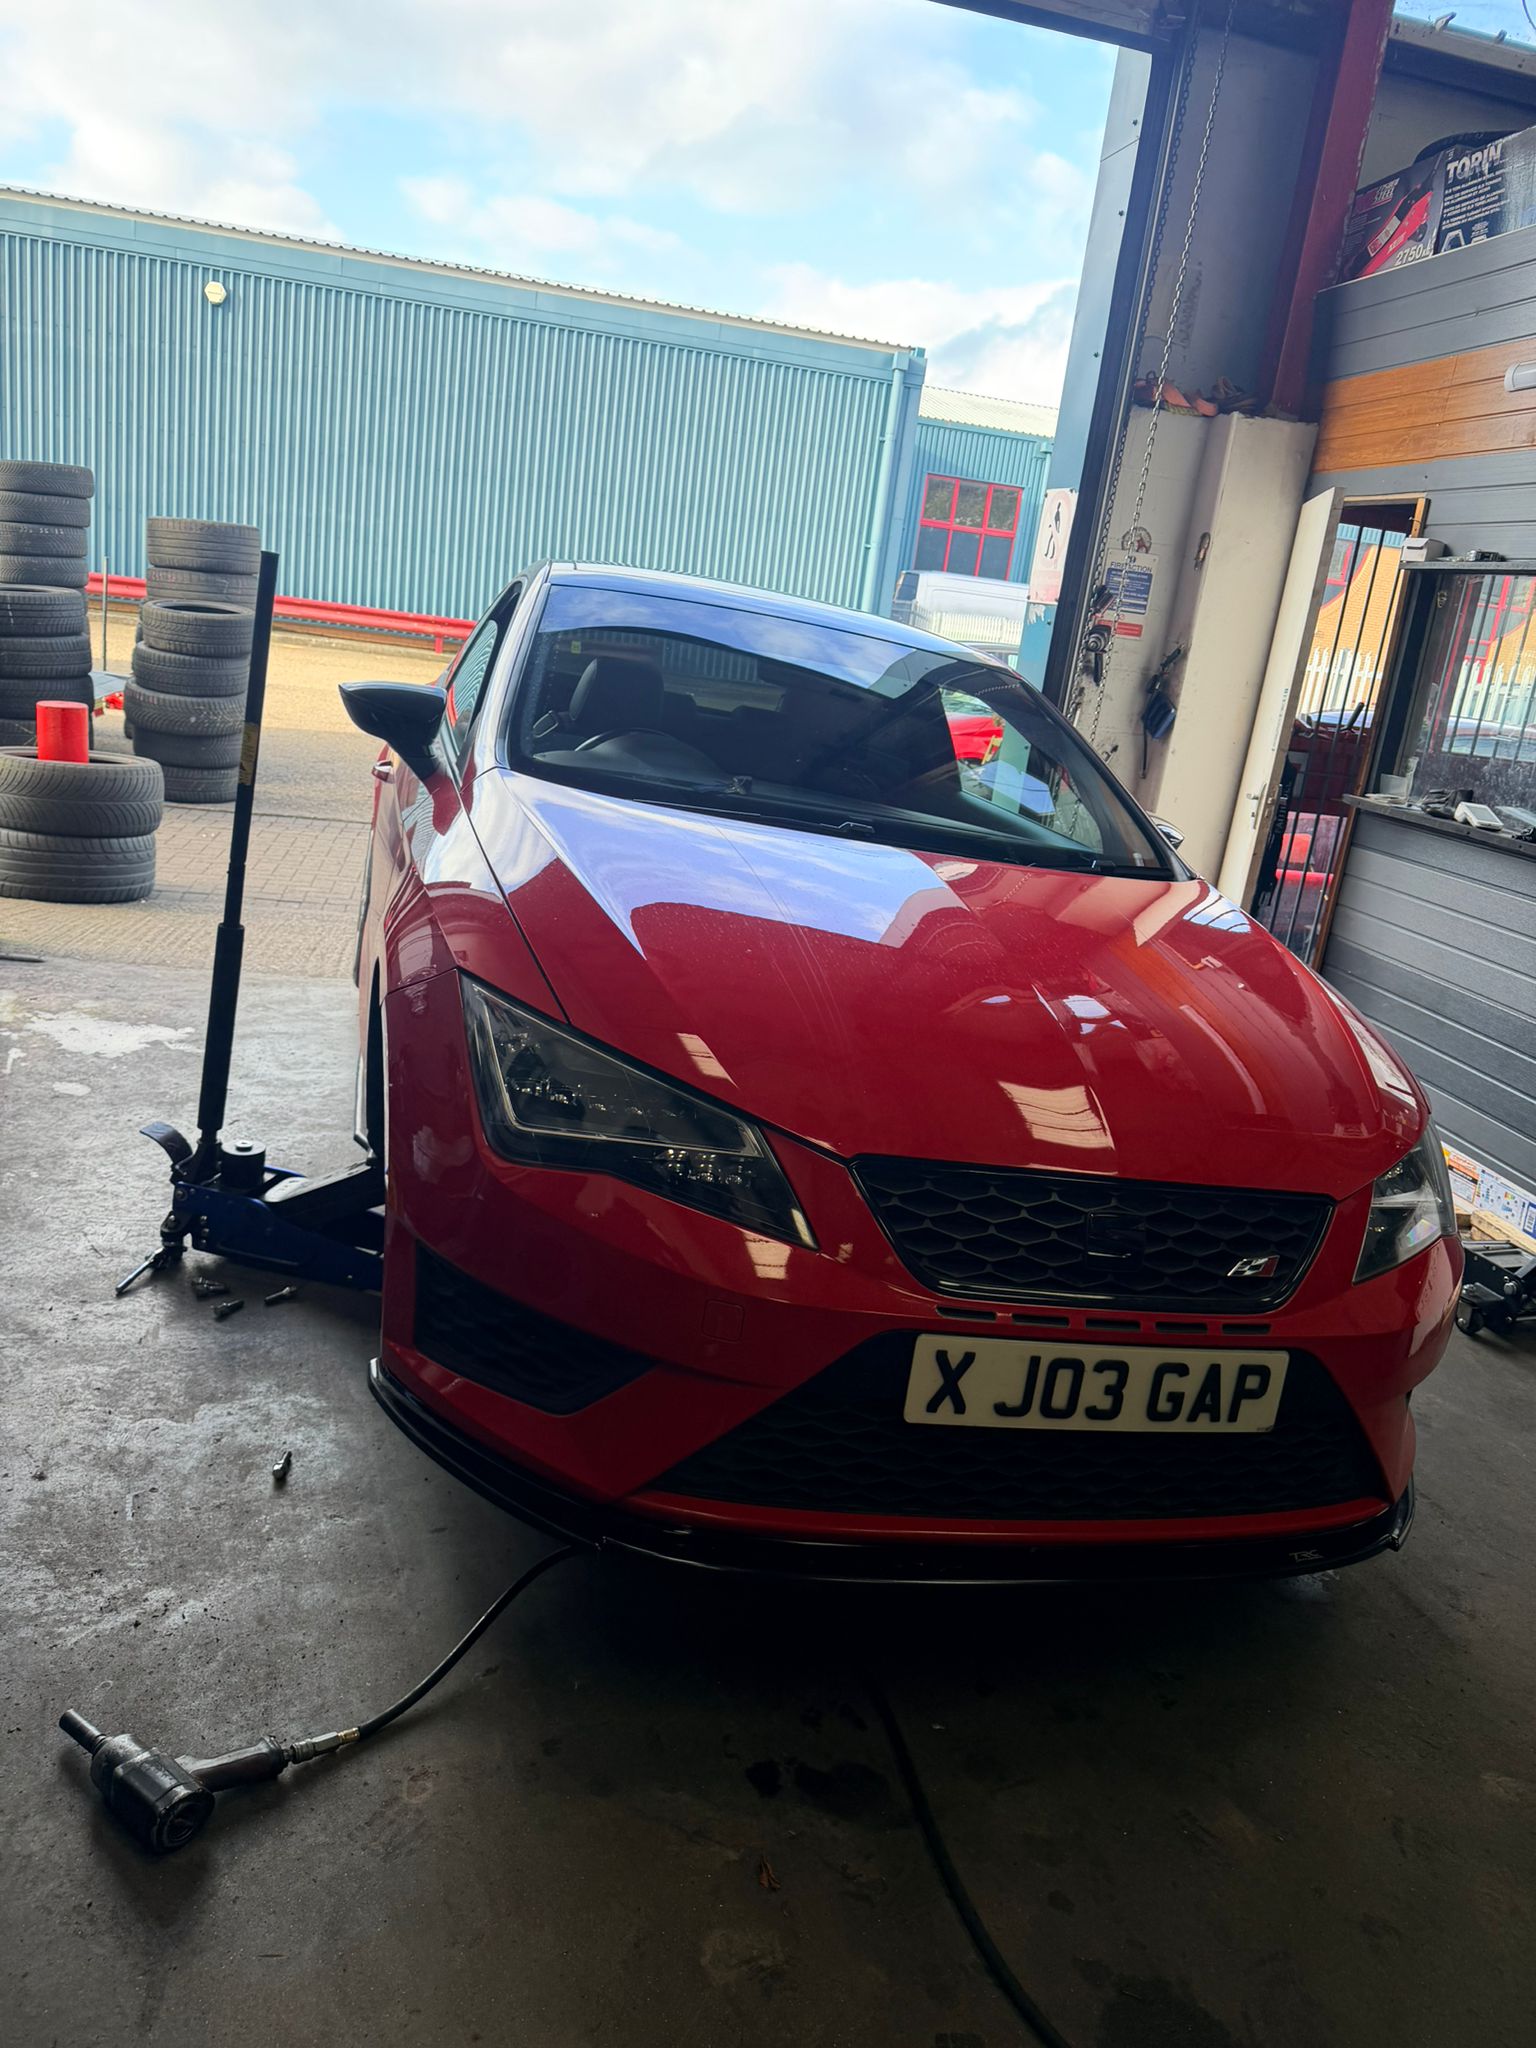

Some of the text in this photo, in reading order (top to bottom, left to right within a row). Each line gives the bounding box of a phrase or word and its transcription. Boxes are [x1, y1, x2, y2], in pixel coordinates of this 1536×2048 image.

[1446, 143, 1502, 184] TORIN
[926, 1349, 976, 1415] X
[1146, 1362, 1272, 1423] GAP
